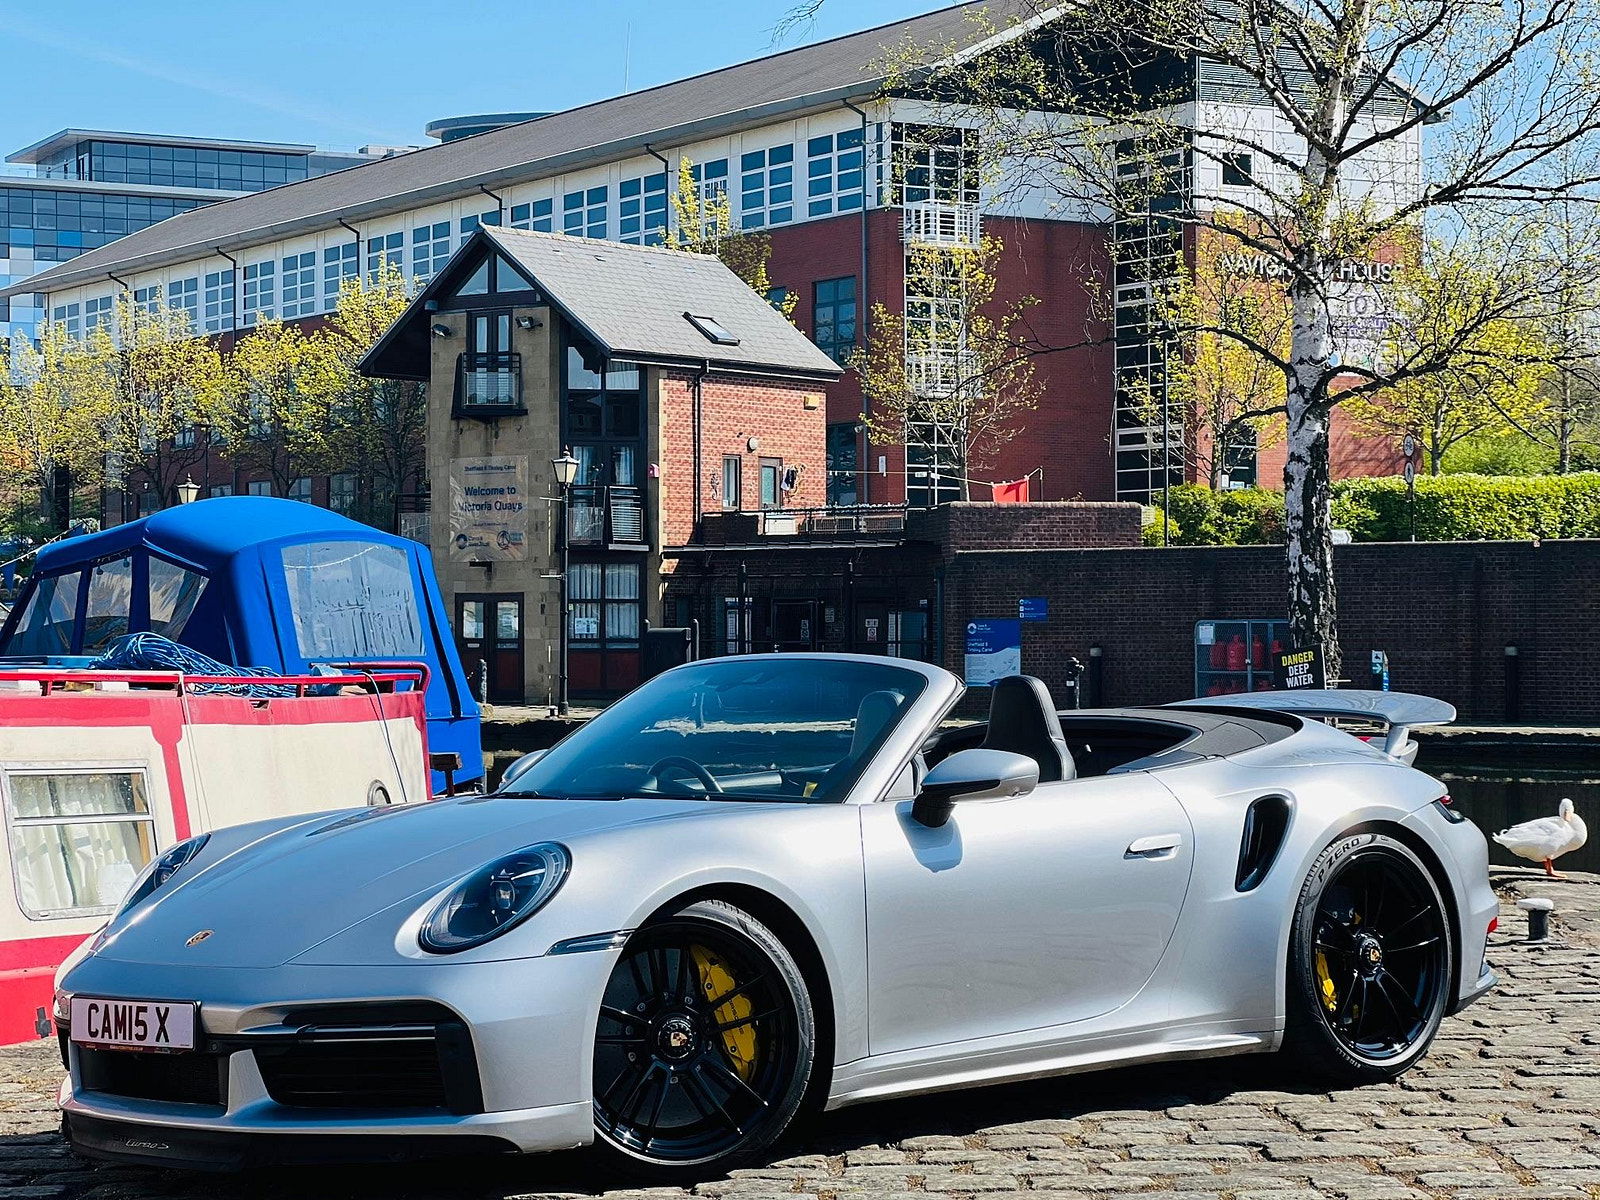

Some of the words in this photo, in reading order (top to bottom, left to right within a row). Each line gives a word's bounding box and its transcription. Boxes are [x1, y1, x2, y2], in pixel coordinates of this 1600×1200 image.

[1220, 253, 1336, 279] NAVIGA
[464, 486, 505, 496] Welcome
[507, 486, 516, 495] to
[494, 500, 523, 513] Quays
[1281, 651, 1315, 667] DANGER
[1288, 663, 1309, 677] DEEP
[1285, 673, 1314, 688] WATER
[1325, 837, 1360, 870] ZERO
[155, 1006, 170, 1043] X
